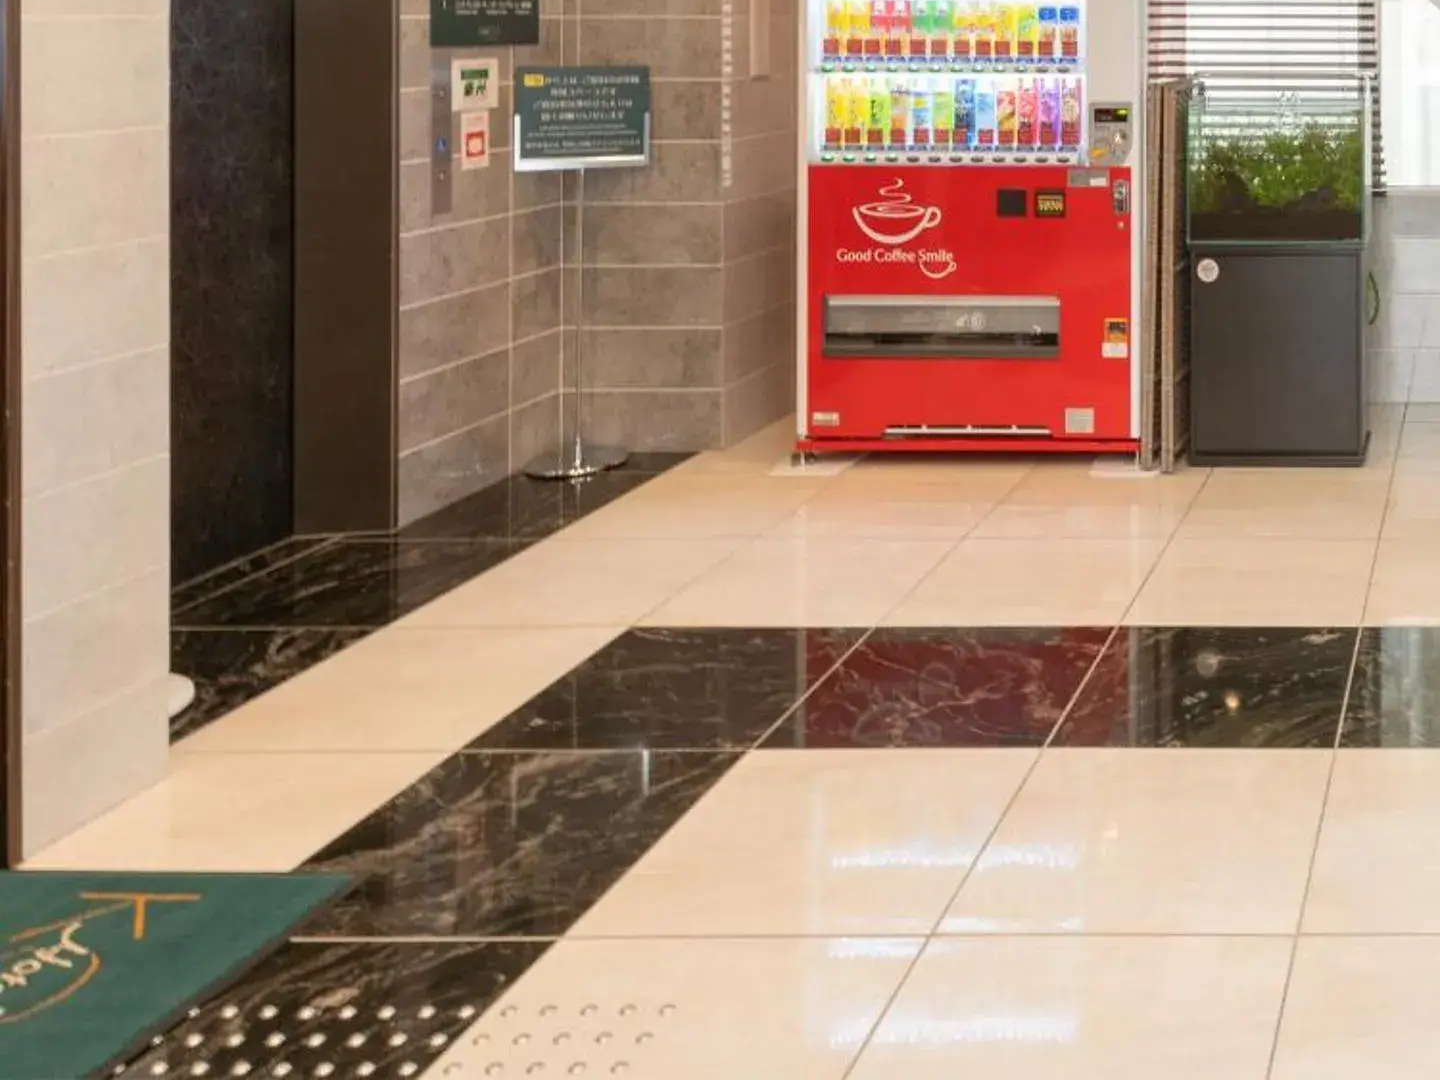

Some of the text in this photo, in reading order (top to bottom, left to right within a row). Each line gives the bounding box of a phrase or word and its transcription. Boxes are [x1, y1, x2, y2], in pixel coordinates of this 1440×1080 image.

[836, 248, 954, 263] Good Coffee Smile
